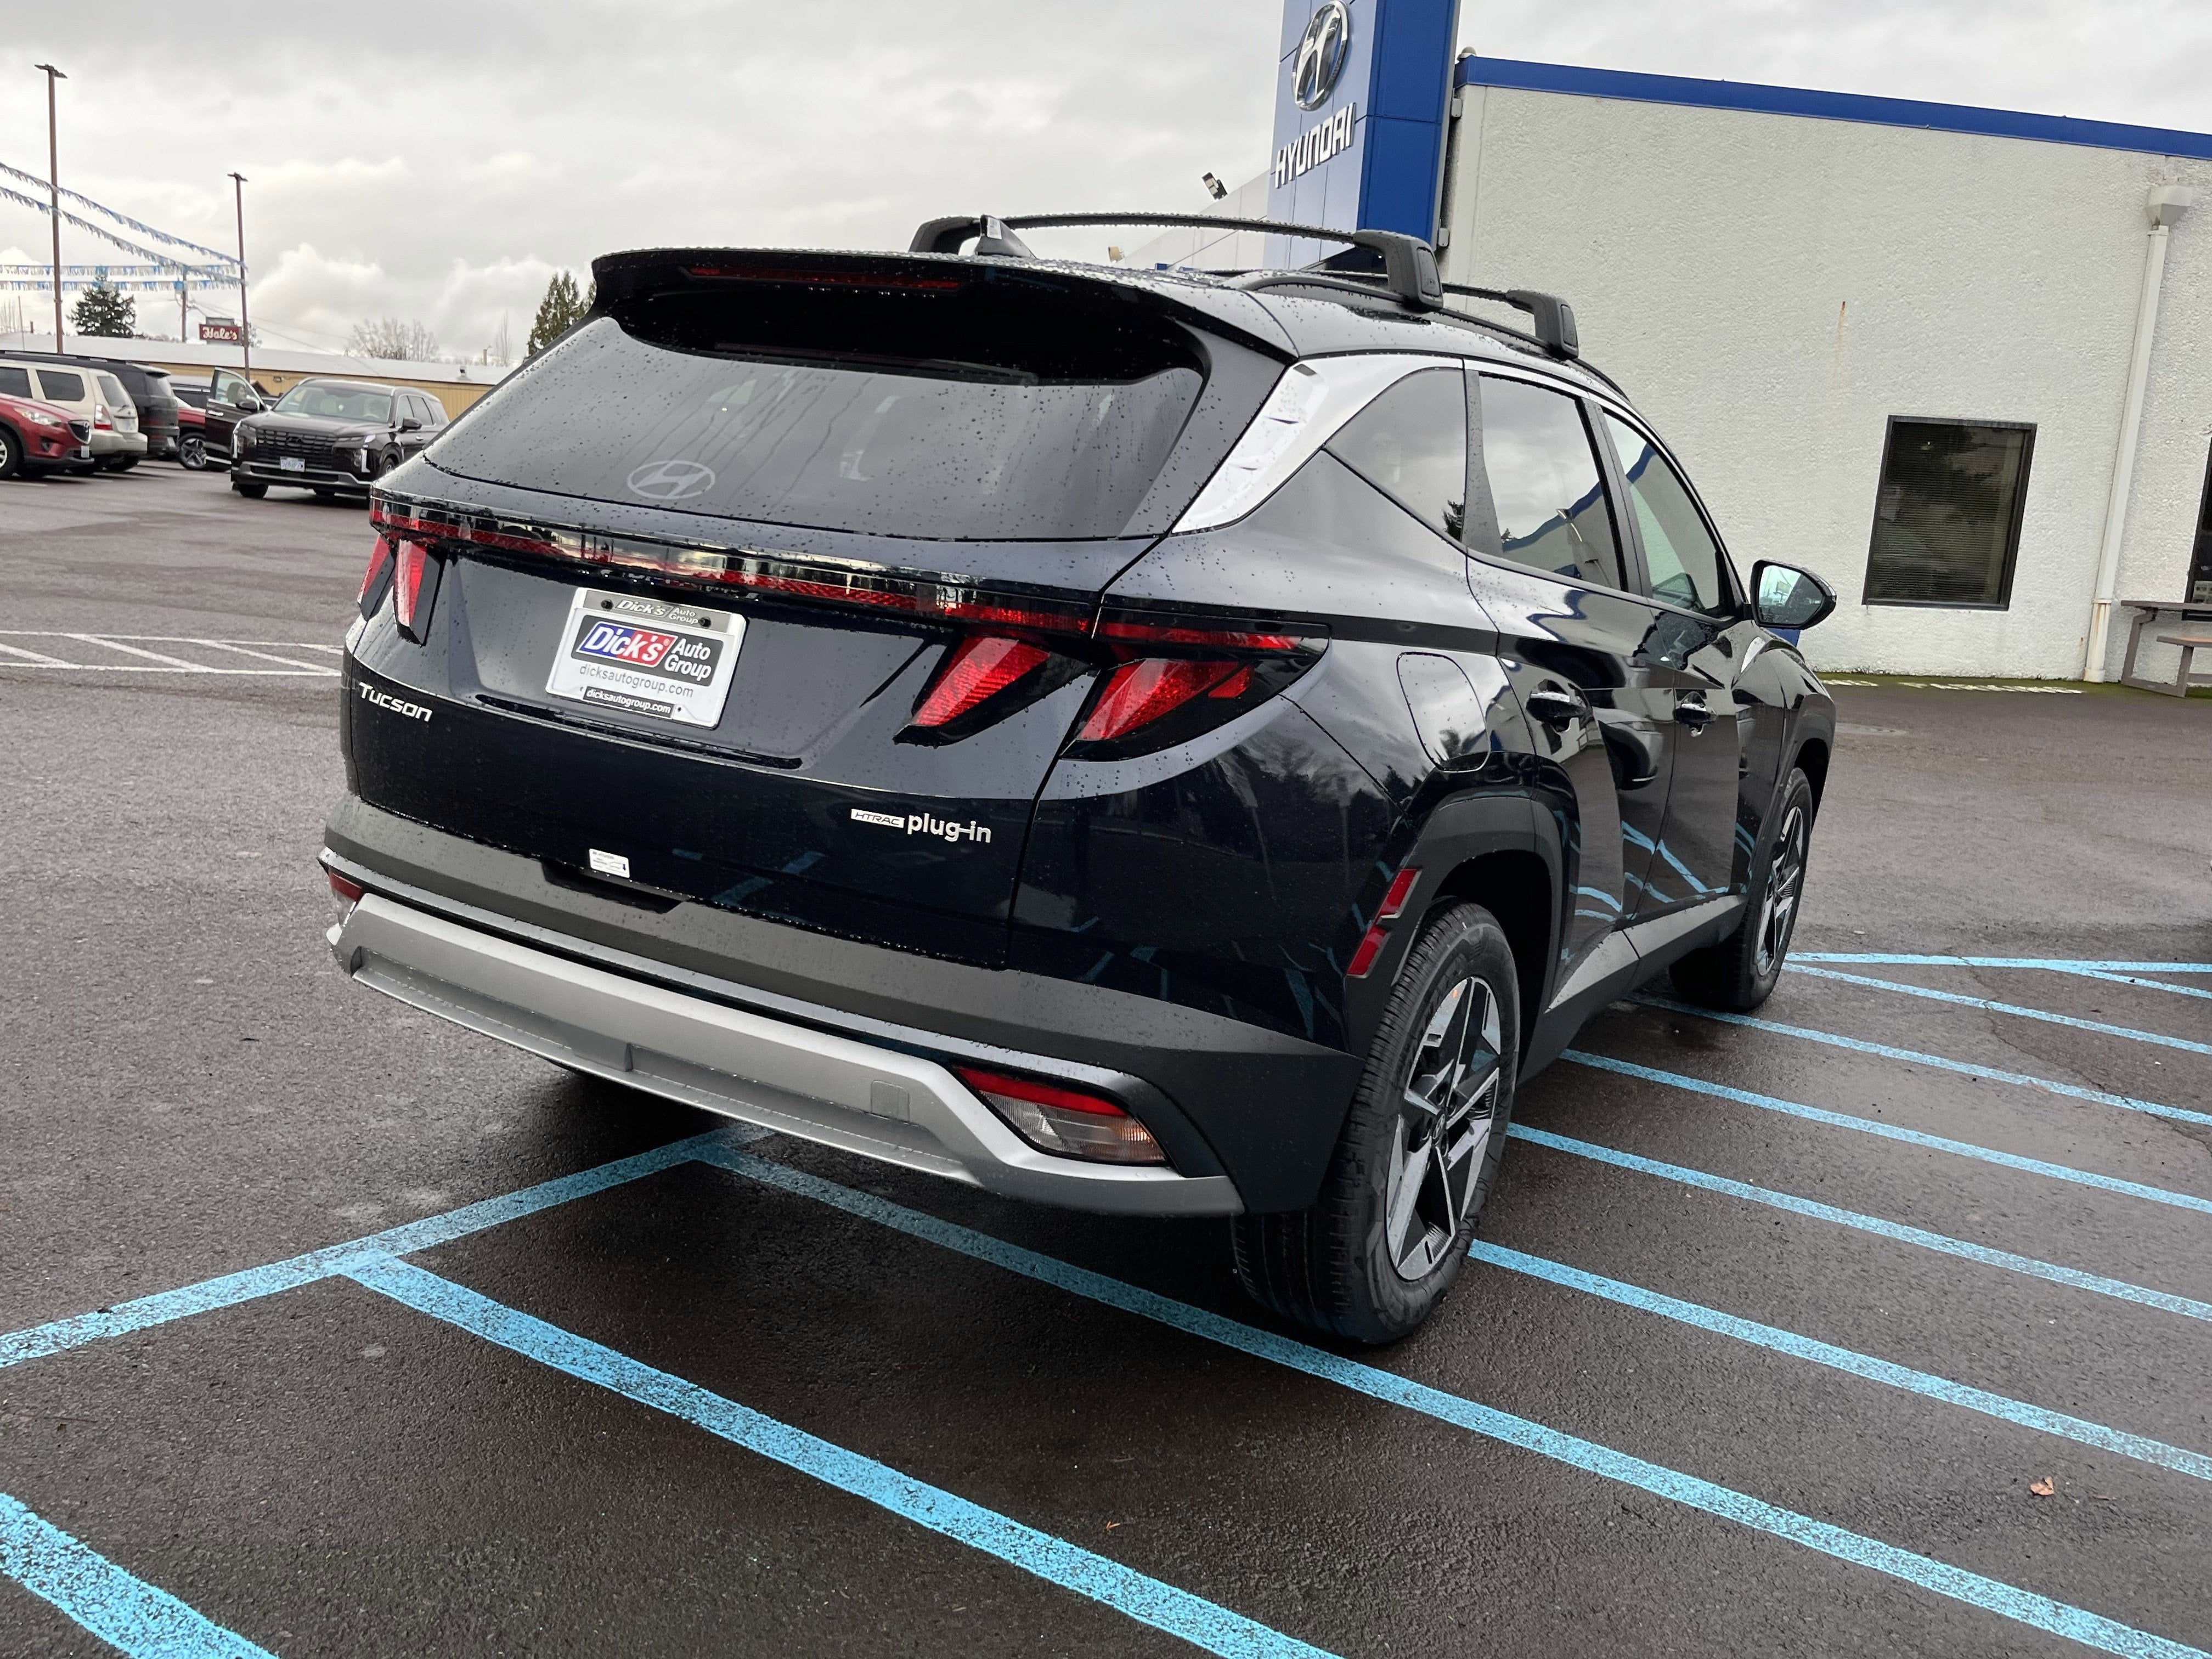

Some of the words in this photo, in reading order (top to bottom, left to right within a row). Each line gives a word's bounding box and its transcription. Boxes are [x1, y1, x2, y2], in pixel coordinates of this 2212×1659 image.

[1274, 102, 1357, 189] HYUNDAI
[202, 326, 238, 341] Hale's
[617, 600, 666, 616] Dick's
[669, 613, 699, 624] Group
[672, 607, 697, 617] Auto
[584, 626, 664, 662] Dick's
[672, 638, 711, 661] Auto
[664, 654, 712, 681] Group
[579, 664, 694, 698] dicksautogroup.com
[586, 689, 671, 714] dicksautogroup.com
[855, 811, 901, 826] HTRAC
[907, 813, 991, 843] plug-in
